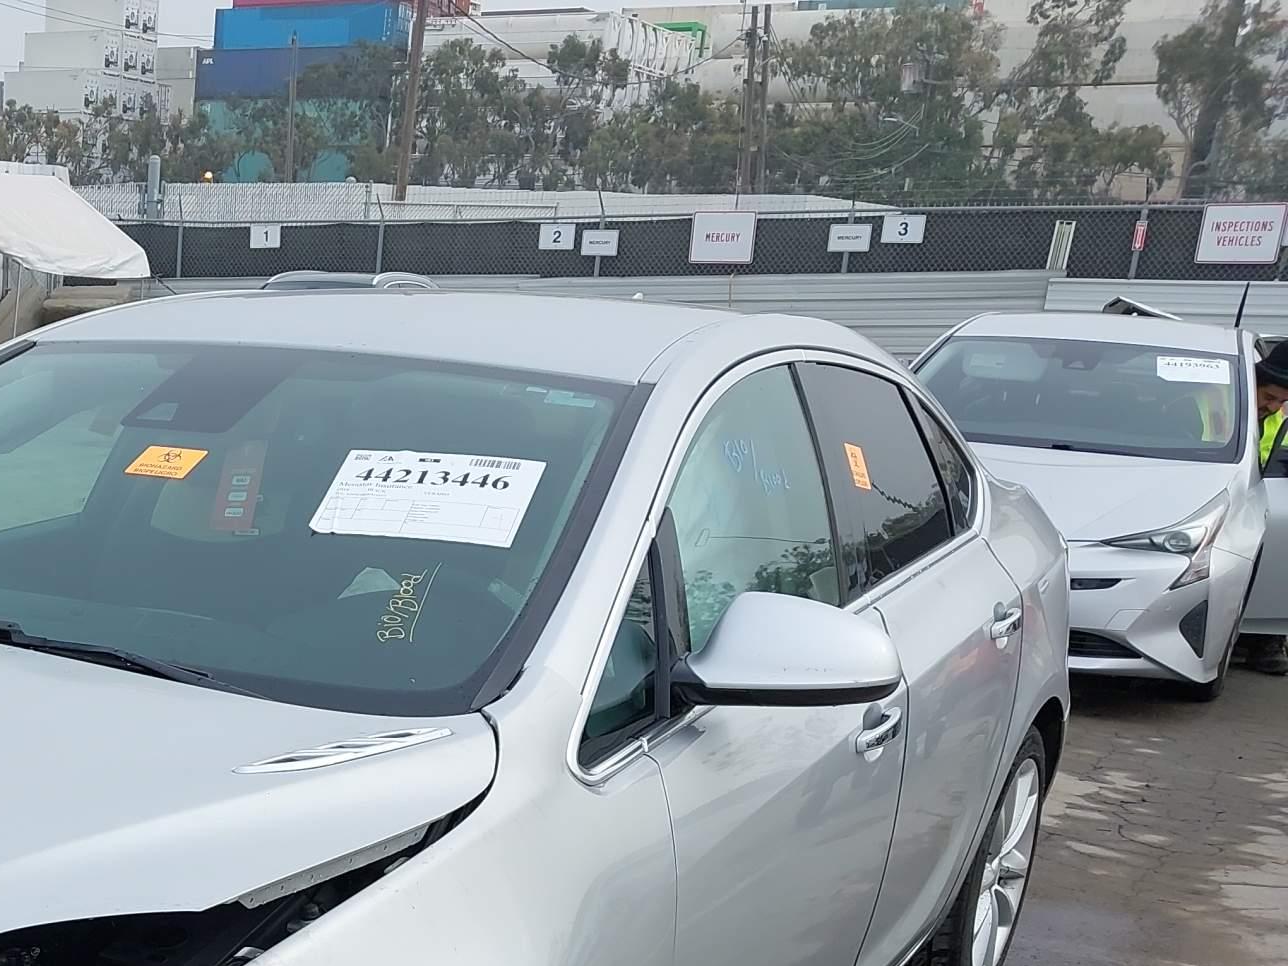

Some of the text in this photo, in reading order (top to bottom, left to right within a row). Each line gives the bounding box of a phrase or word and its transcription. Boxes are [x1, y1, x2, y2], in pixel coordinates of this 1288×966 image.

[897, 222, 909, 236] 3
[1210, 220, 1274, 233] INSPECTIONS
[264, 230, 269, 242] 1
[552, 230, 562, 244] 2
[705, 232, 740, 242] MERCURY
[1216, 235, 1263, 247] VEHICLES
[355, 466, 512, 491] 44213446
